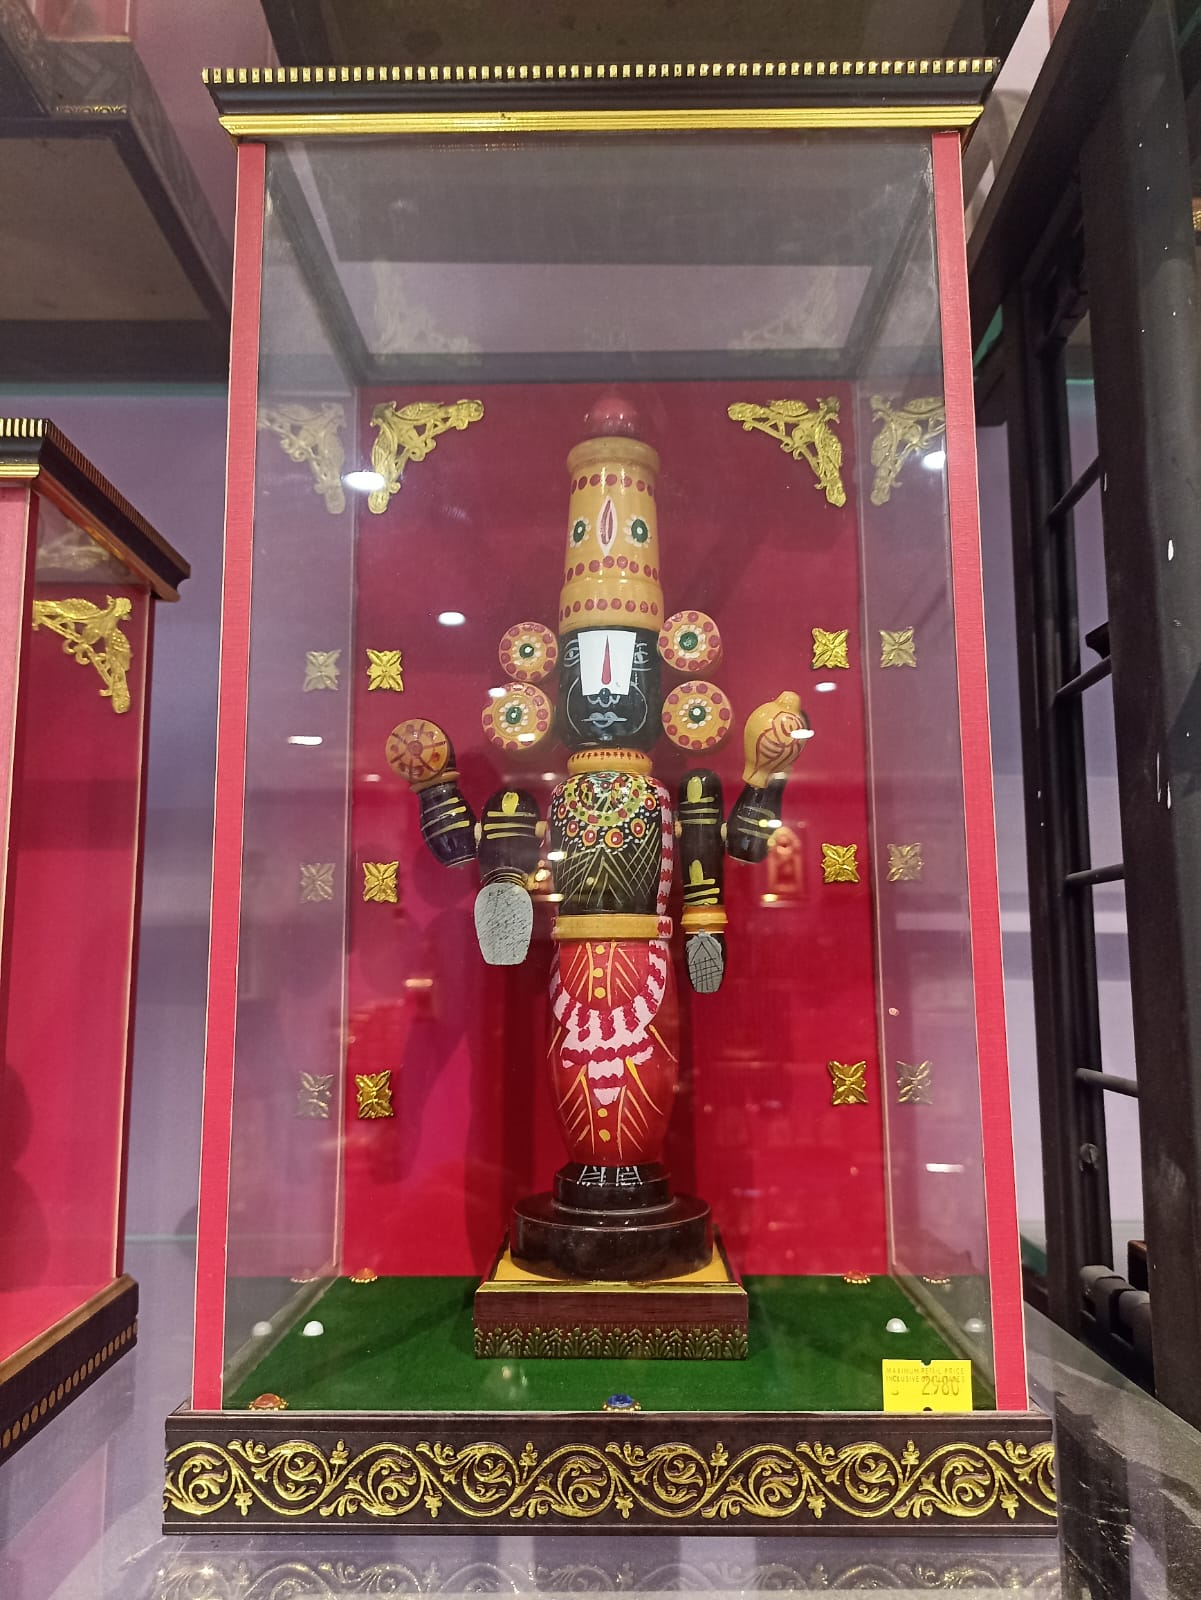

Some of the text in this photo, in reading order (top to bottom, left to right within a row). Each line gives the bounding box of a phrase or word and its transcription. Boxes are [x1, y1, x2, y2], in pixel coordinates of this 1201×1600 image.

[886, 1367, 919, 1375] MAXIMUM
[945, 1367, 965, 1375] PRICE
[886, 1375, 919, 1383] INCLUSIVE
